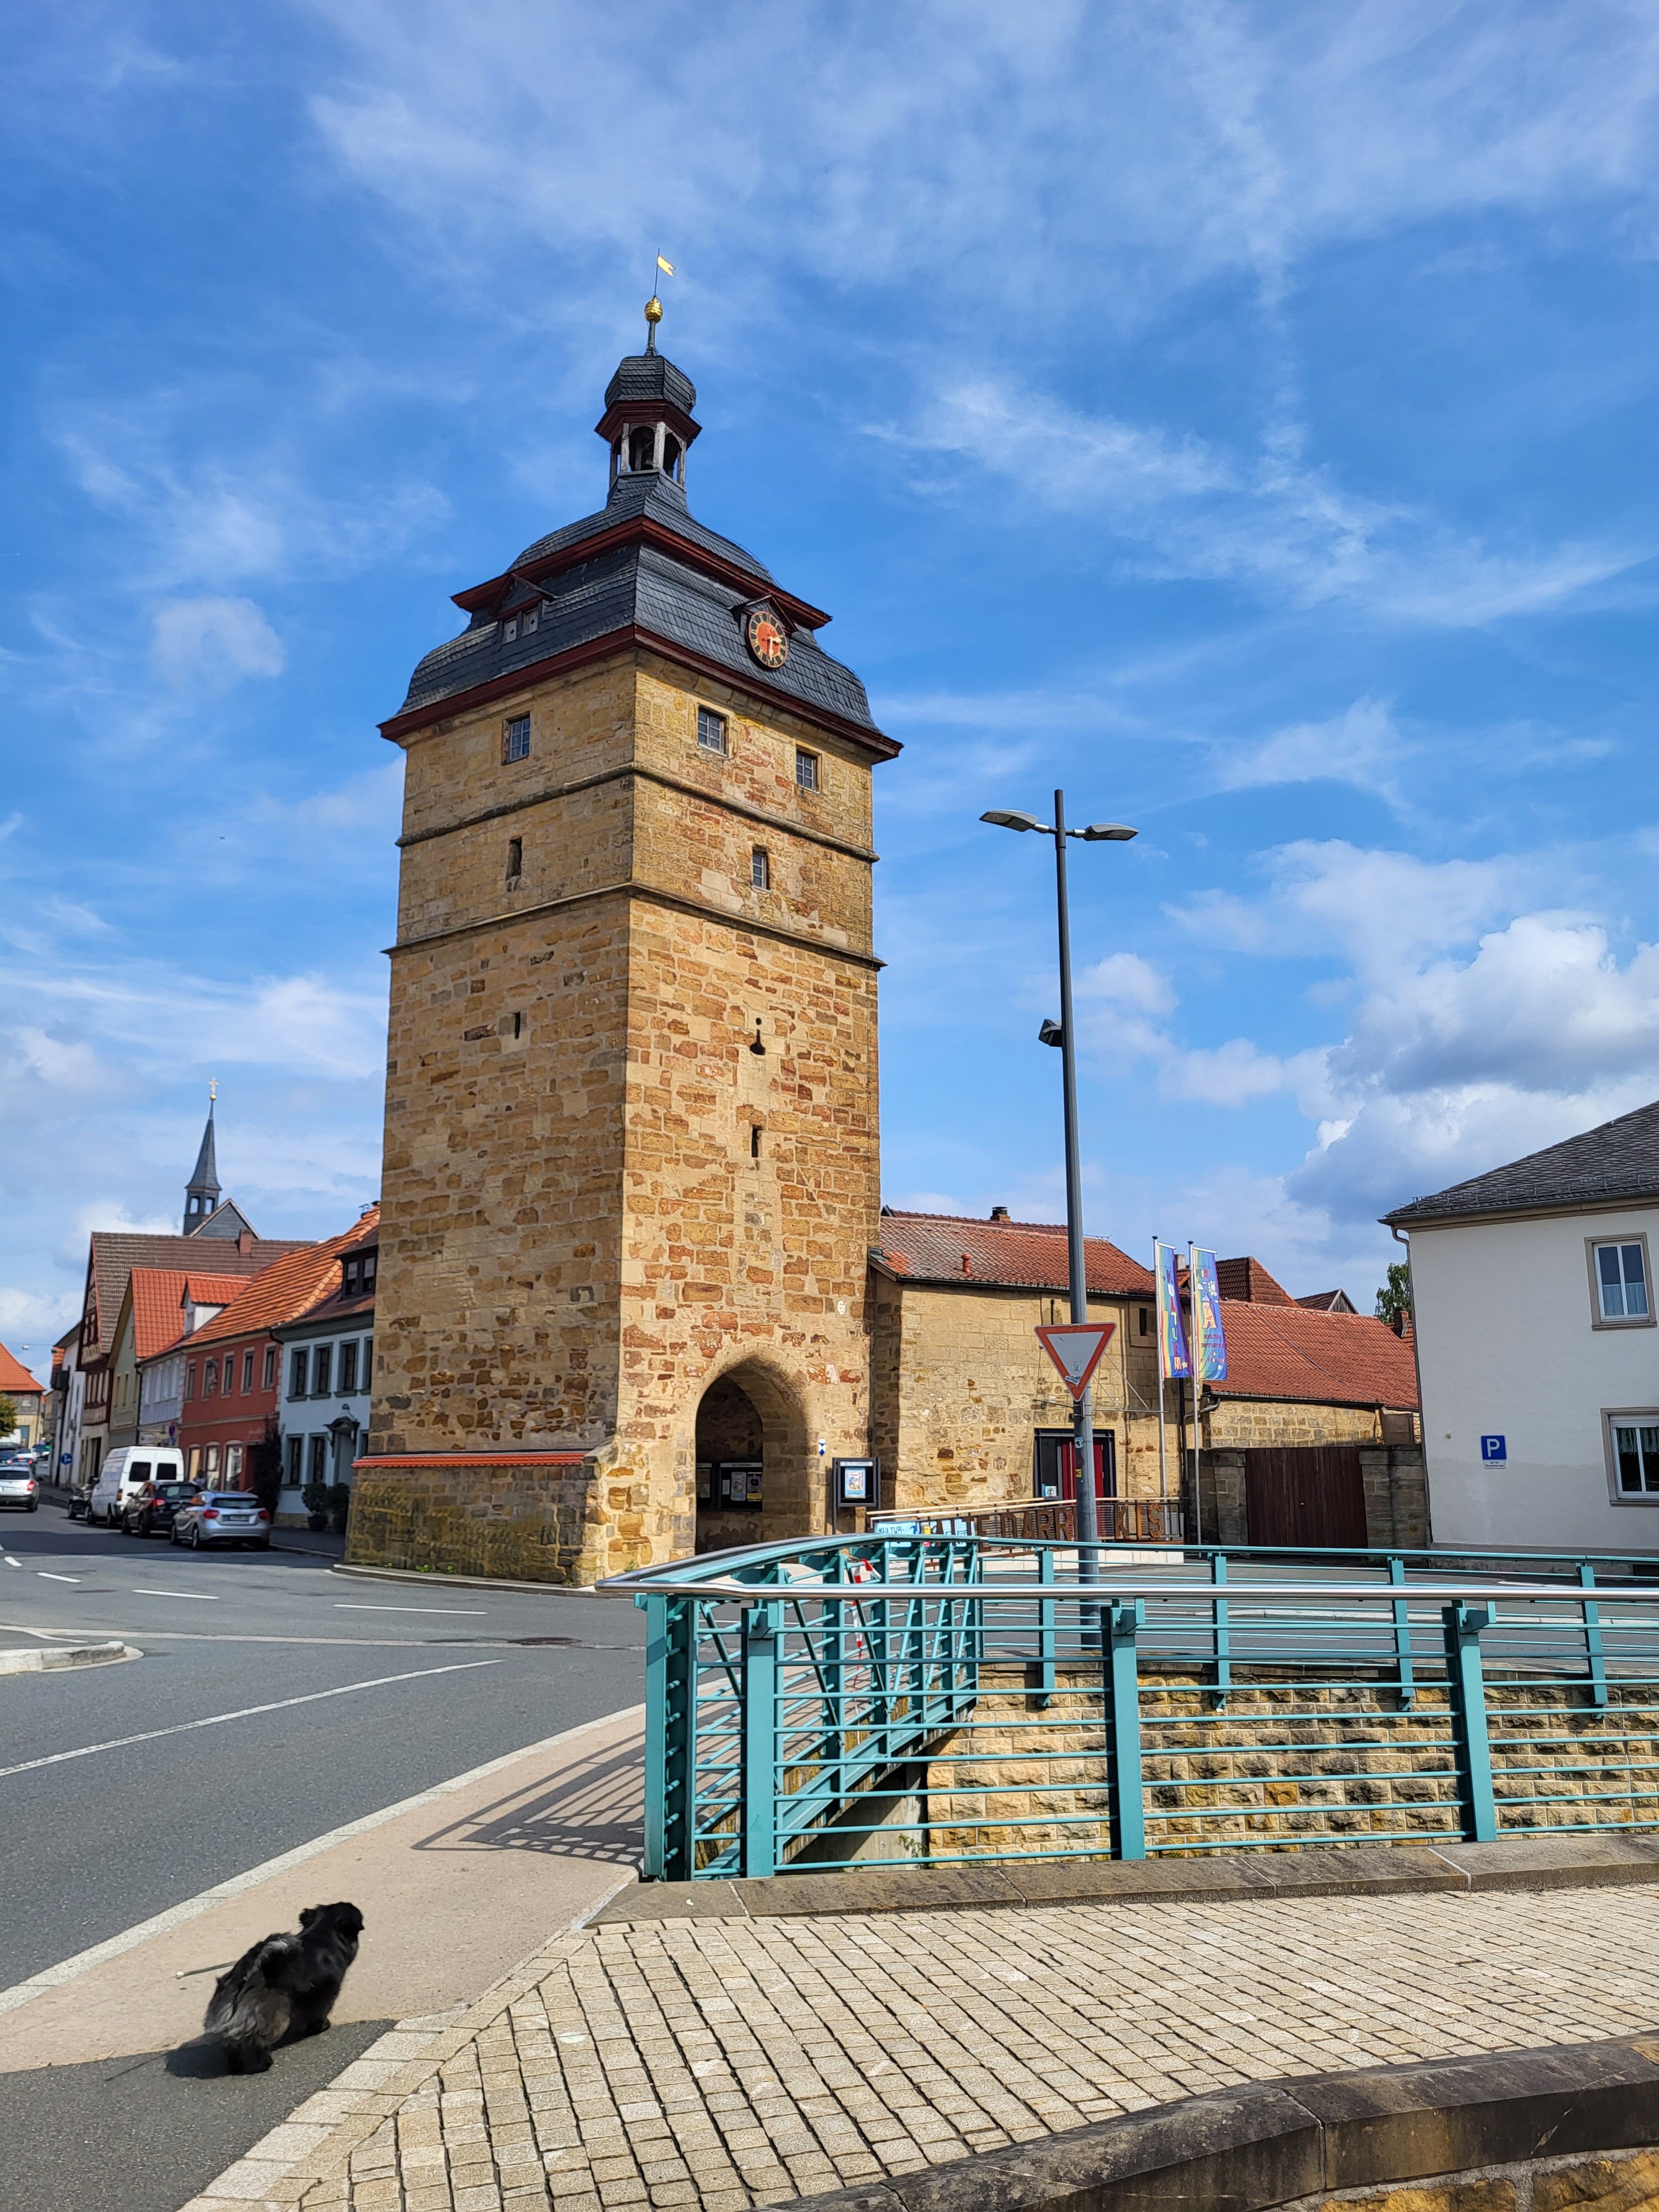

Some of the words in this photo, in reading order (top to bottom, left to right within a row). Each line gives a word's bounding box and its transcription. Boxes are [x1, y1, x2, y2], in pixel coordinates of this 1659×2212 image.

[1486, 1438, 1500, 1457] P
[1000, 1505, 1078, 1549] DARR
[1114, 1503, 1165, 1540] KIS
